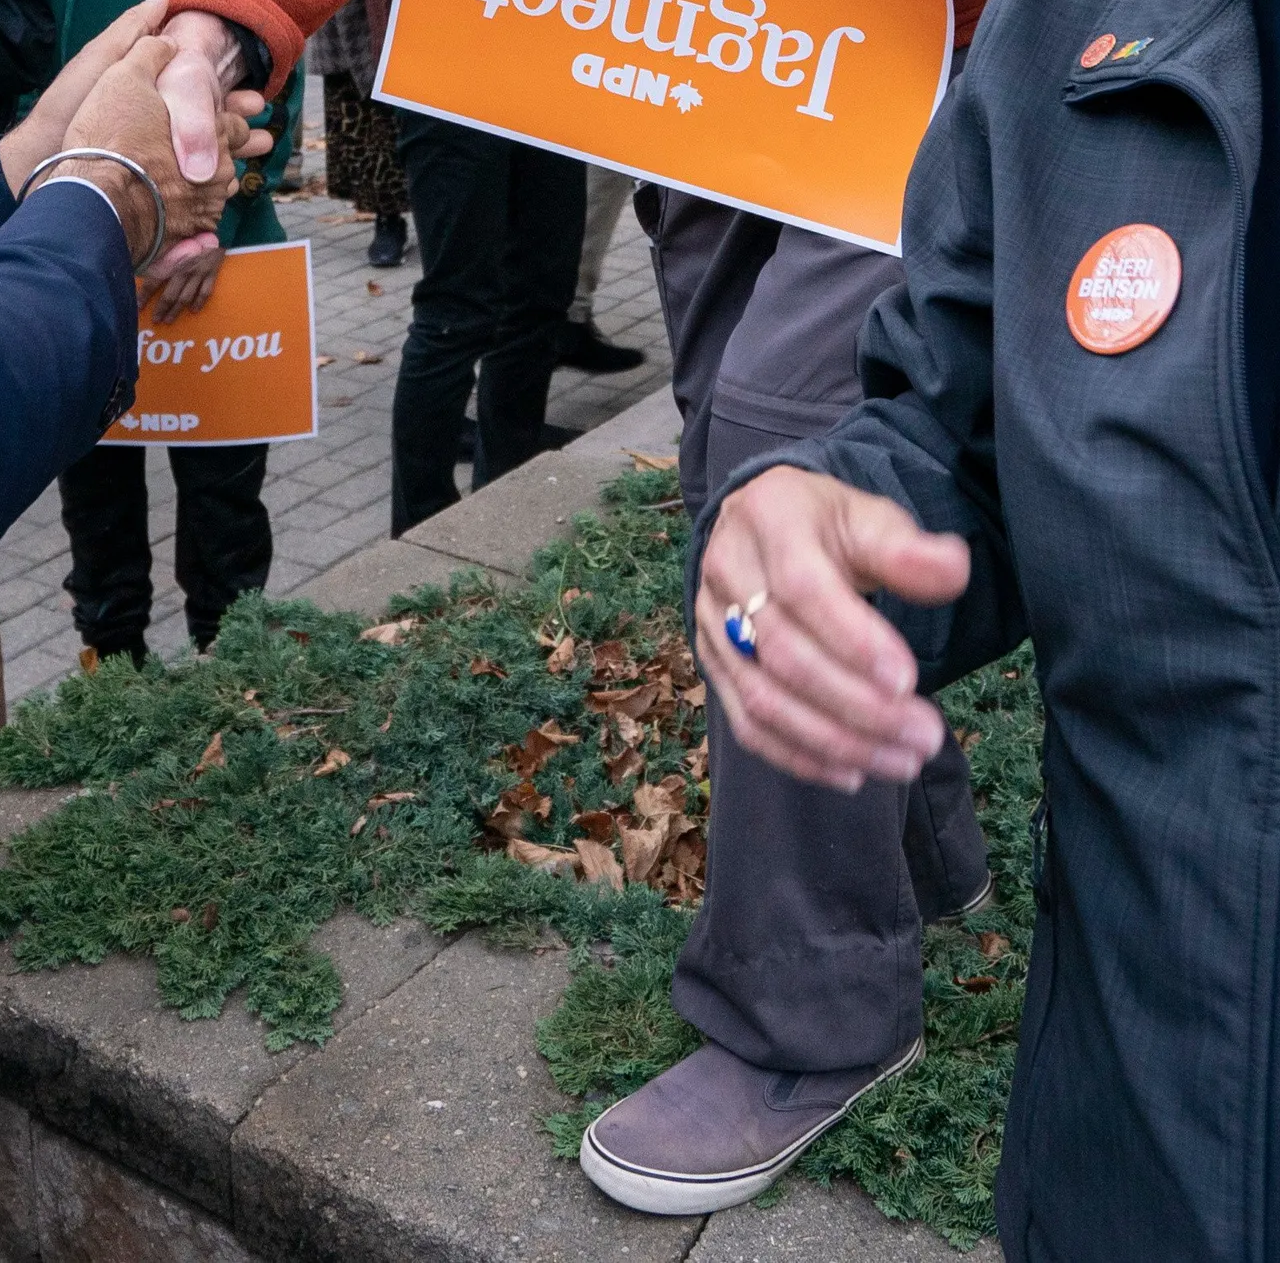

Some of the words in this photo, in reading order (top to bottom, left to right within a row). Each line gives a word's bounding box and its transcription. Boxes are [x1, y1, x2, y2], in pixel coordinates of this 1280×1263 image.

[571, 52, 672, 107] NDP
[1096, 257, 1154, 277] SHERI
[1078, 278, 1160, 299] BENSON
[137, 329, 194, 366] for
[200, 330, 283, 373] you
[140, 413, 200, 432] NDP
